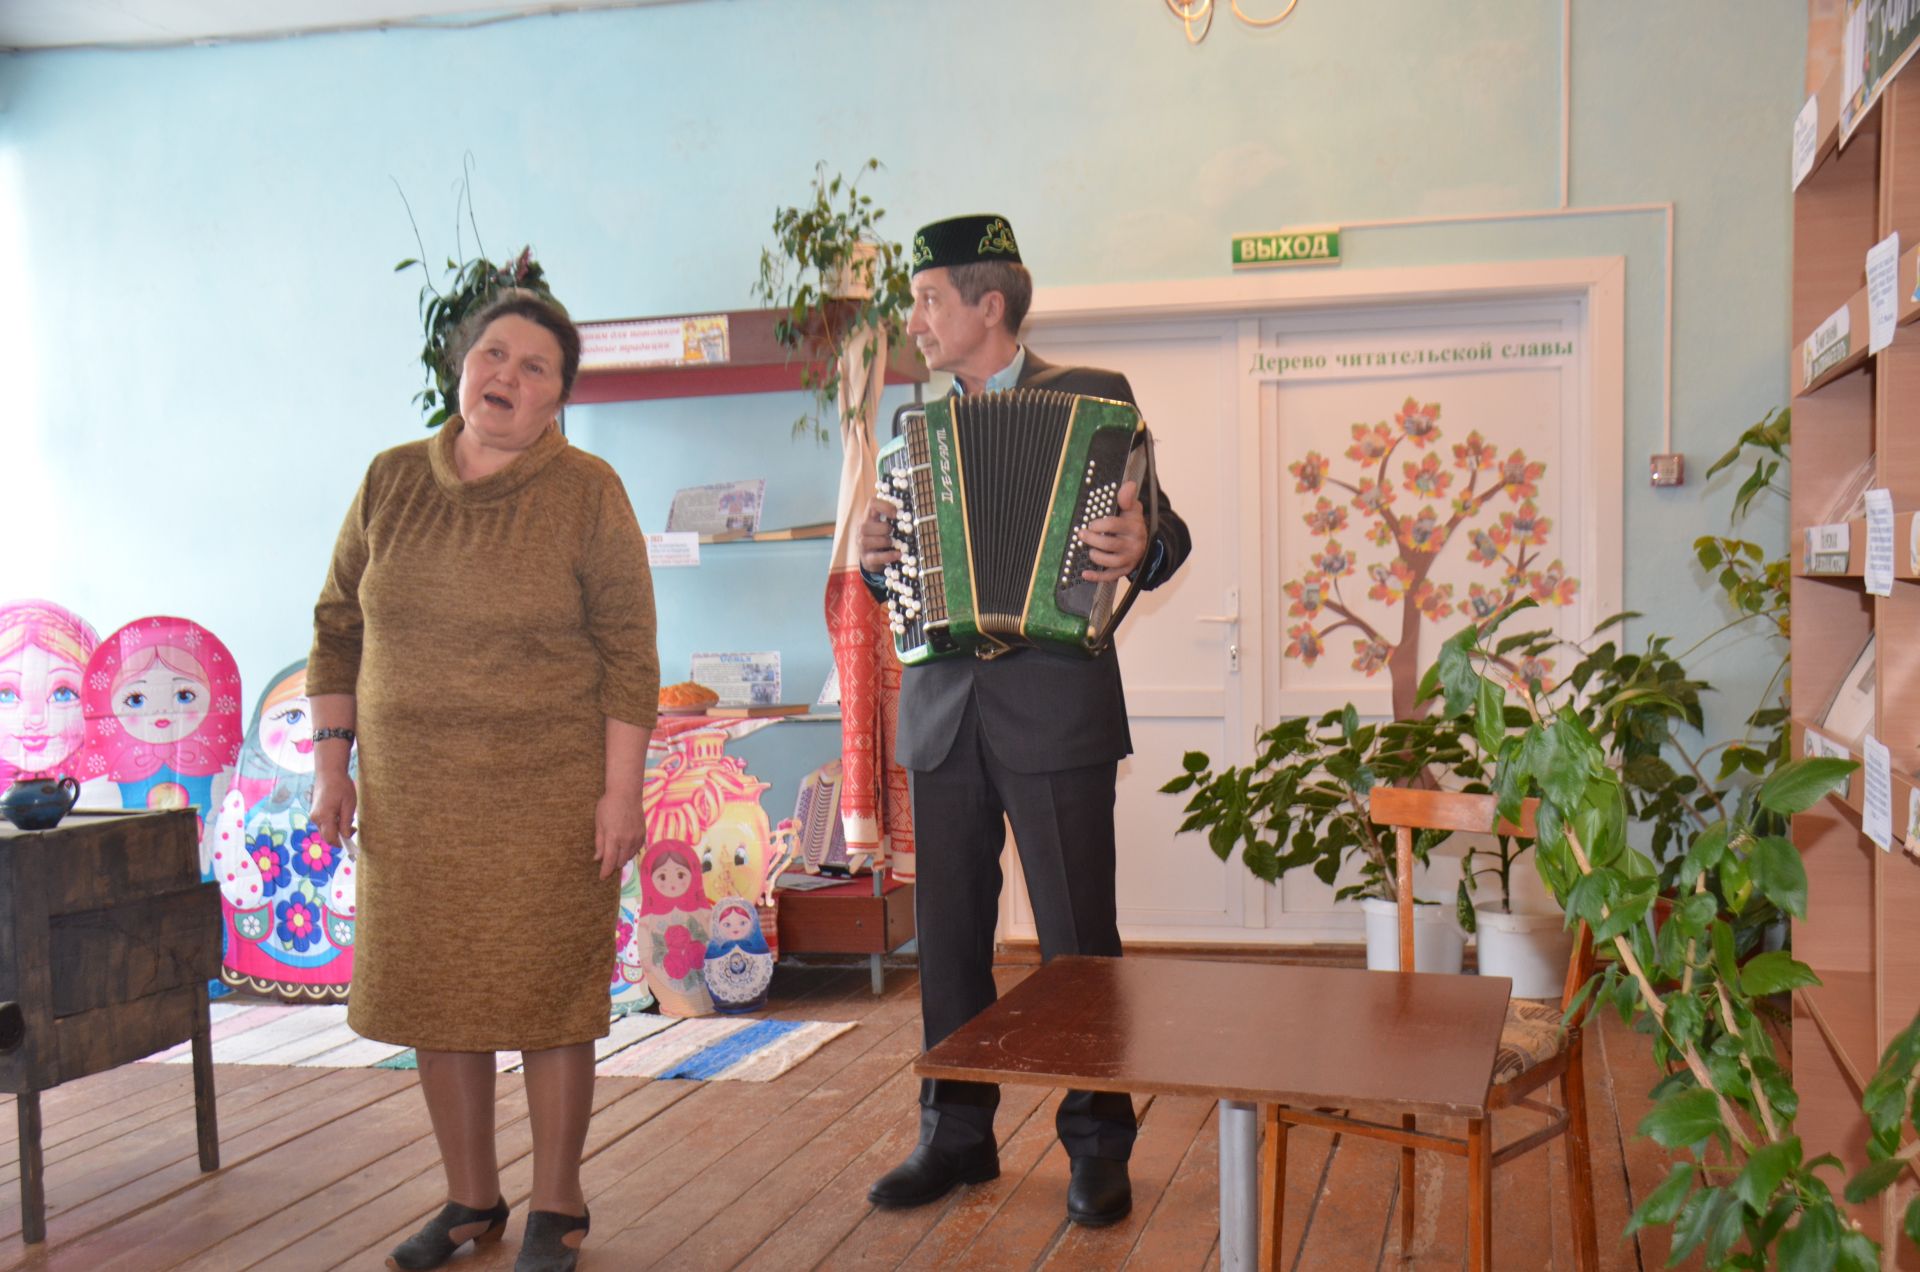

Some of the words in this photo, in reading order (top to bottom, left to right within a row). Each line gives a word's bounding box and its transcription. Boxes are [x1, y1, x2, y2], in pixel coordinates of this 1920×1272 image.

[1241, 233, 1329, 260] ВЫХОД
[1249, 352, 1327, 375] Дерево
[1336, 341, 1493, 366] читательской
[1501, 341, 1573, 359] славы
